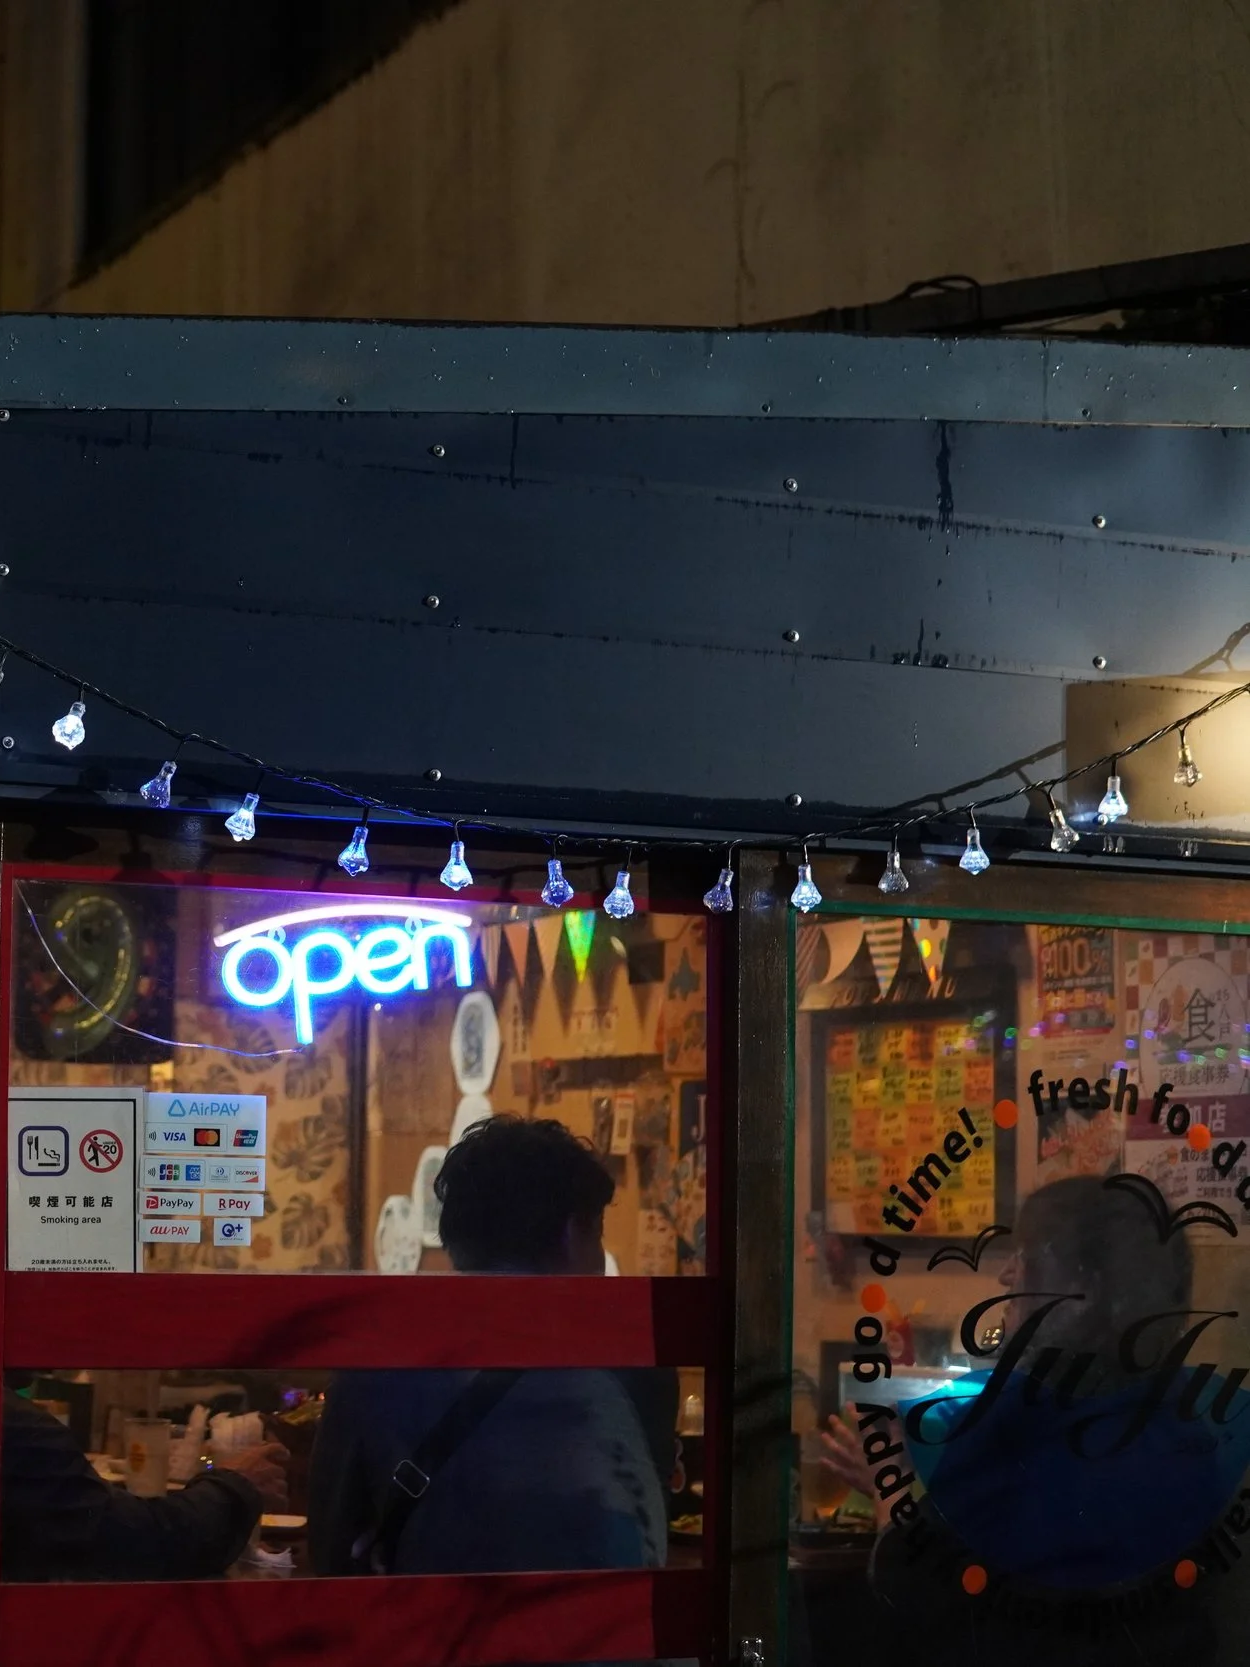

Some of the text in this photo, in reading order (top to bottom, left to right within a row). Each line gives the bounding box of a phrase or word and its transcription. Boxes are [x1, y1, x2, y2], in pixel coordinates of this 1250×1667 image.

[222, 922, 473, 1045] open
[1027, 1068, 1138, 1117] fresh
[163, 1132, 187, 1142] VISA
[103, 1144, 117, 1155] 20
[882, 1107, 984, 1233] time!
[28, 1196, 113, 1208] 喫煙可能店
[160, 1198, 194, 1210] PayPay
[229, 1198, 251, 1210] Pay
[40, 1215, 79, 1226] Smoking
[171, 1226, 190, 1235] PAY
